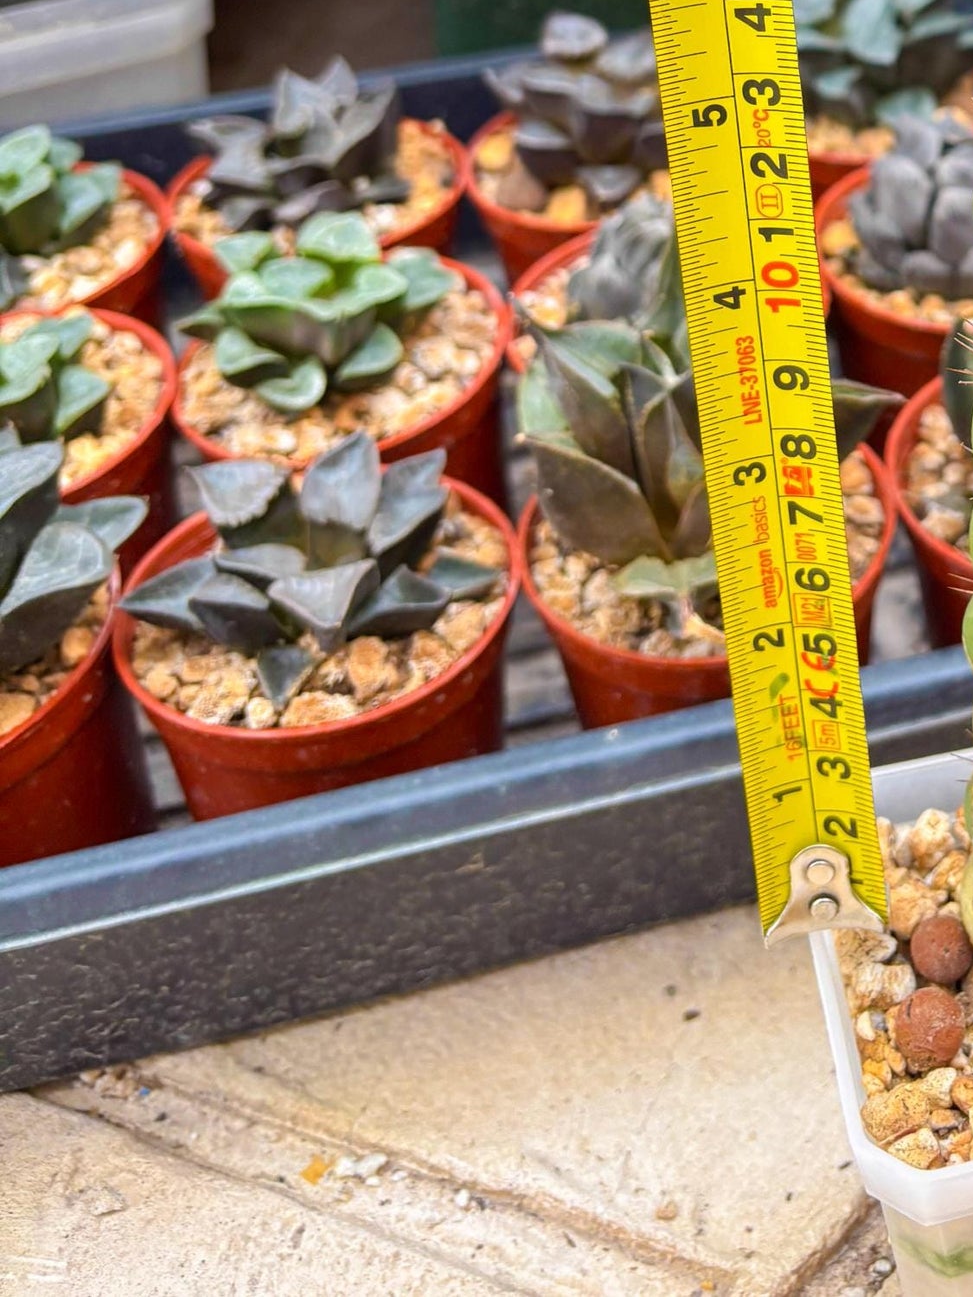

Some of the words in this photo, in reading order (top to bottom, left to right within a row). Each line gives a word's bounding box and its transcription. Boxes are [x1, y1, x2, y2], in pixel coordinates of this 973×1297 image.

[734, 3, 772, 33] 4
[742, 78, 781, 107] 3
[692, 104, 728, 128] 5
[750, 152, 789, 180] 2
[758, 227, 794, 242] 1
[713, 286, 746, 310] 4
[761, 261, 802, 313] 10
[735, 335, 763, 425] LNE-37063
[773, 365, 810, 391] 9
[780, 434, 817, 460] 8
[733, 461, 767, 487] 3
[788, 500, 824, 525] 7
[794, 532, 817, 561] 0071
[794, 567, 831, 592] 6
[752, 628, 786, 652] 2
[802, 633, 838, 657] 5
[809, 696, 843, 719] 4
[819, 723, 838, 745] 5m
[816, 755, 852, 779] 3
[772, 785, 803, 803] 1
[823, 815, 859, 839] 2
